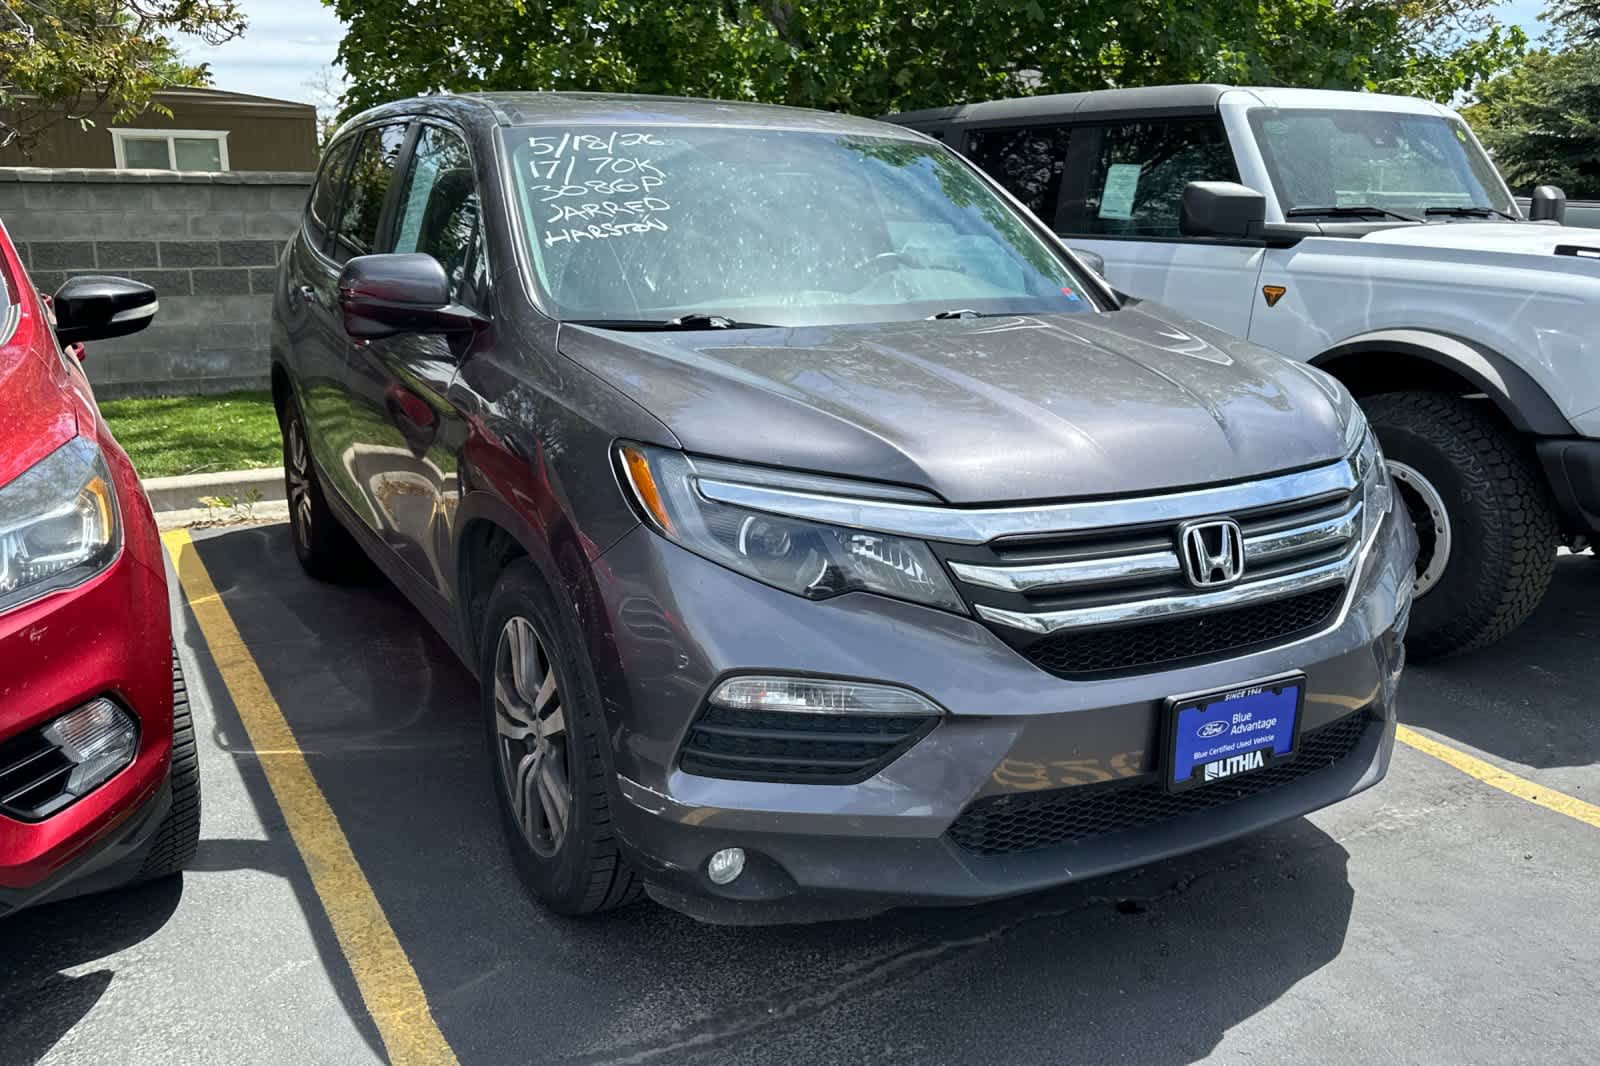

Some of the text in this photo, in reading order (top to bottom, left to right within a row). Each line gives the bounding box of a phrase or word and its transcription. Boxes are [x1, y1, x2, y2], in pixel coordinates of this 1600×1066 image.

[588, 157, 667, 178] 70K
[547, 198, 671, 223] JARRED
[1224, 690, 1246, 701] SINCE
[1230, 717, 1277, 736] Advantage
[1232, 712, 1253, 724] Blue
[1193, 750, 1208, 760] Blue
[1209, 743, 1235, 755] Certified
[1253, 734, 1275, 746] Vehicle
[1219, 750, 1264, 777] LITHIA
